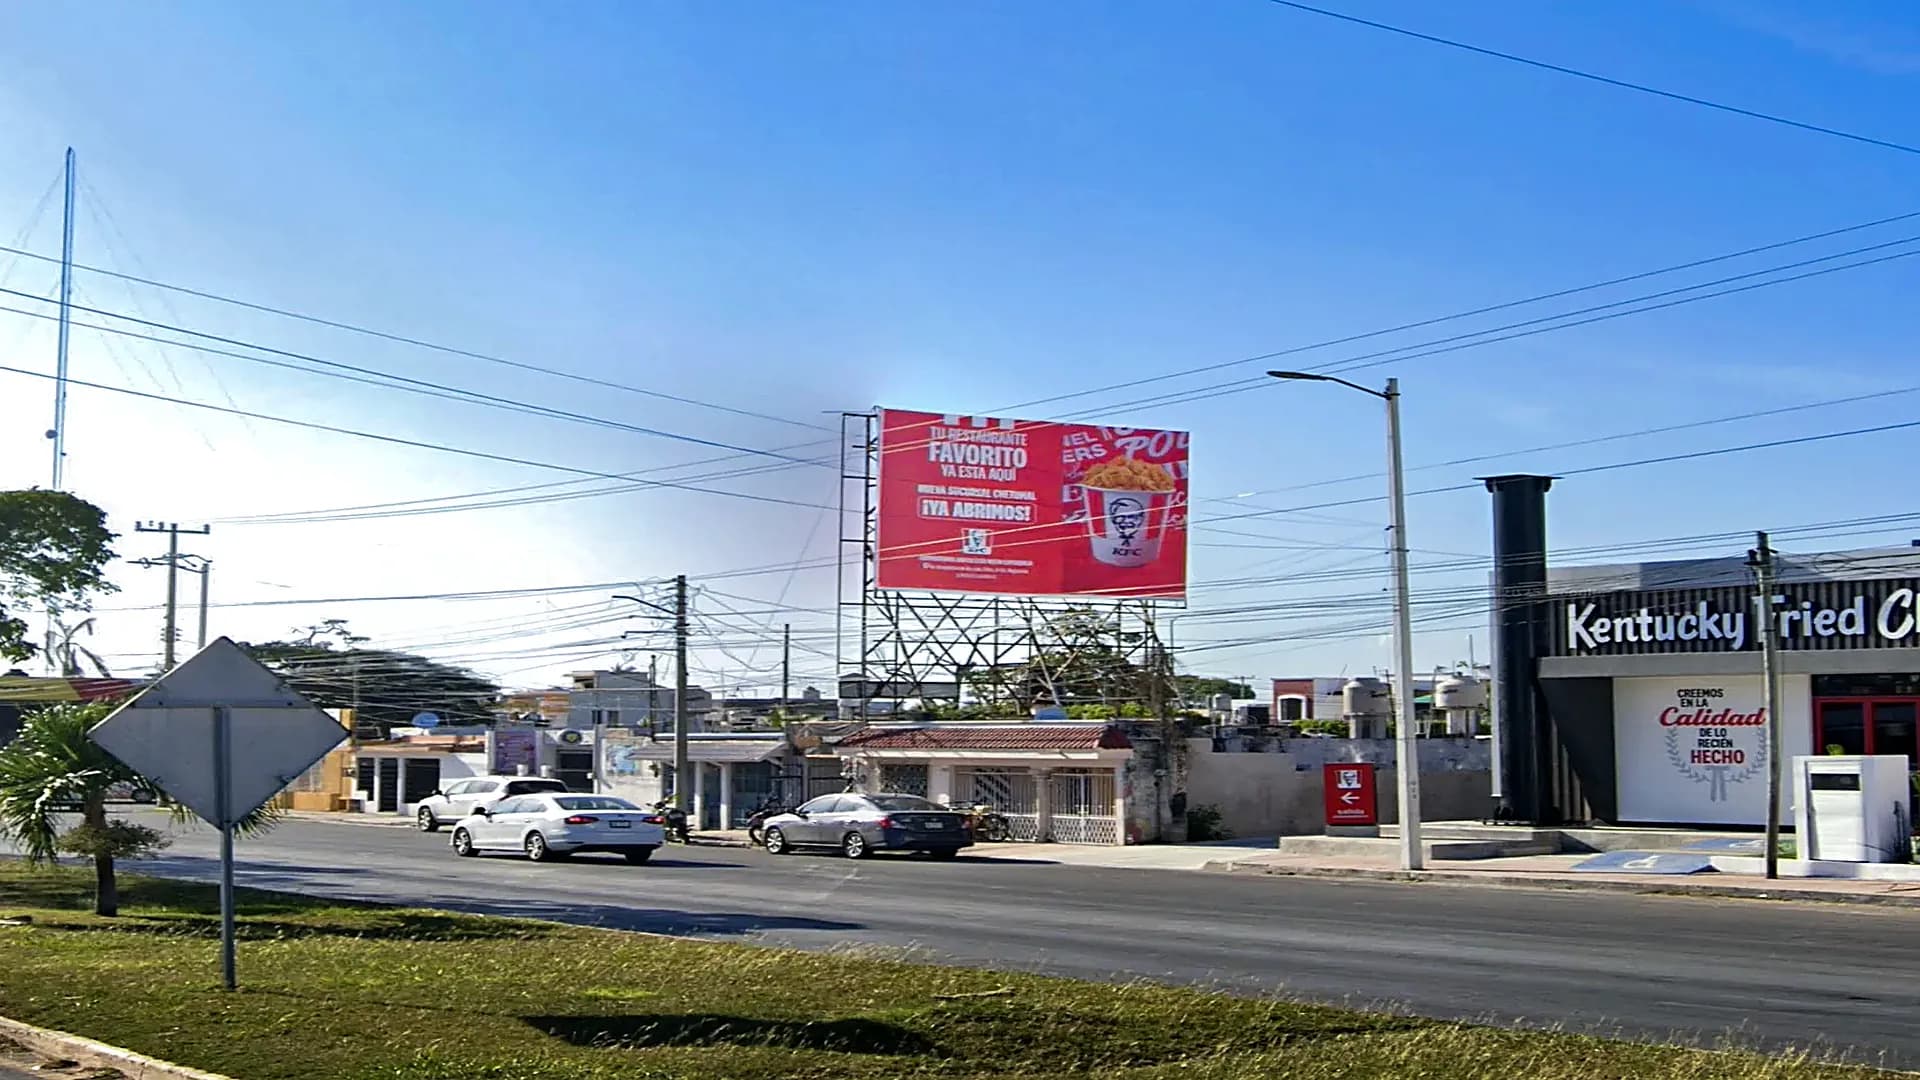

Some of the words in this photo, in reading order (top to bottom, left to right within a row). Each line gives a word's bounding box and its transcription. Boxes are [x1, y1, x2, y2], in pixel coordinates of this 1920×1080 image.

[928, 441, 1028, 468] FAVORITO
[941, 464, 956, 477] YA
[952, 502, 1032, 521] ABRIMOS!
[1567, 600, 1745, 650] Kentucky
[1677, 688, 1724, 698] CREEMOS
[1680, 698, 1693, 707] EN
[1696, 698, 1709, 707] LA
[1659, 706, 1767, 726] Calidad
[1699, 728, 1712, 737] DE
[1715, 728, 1727, 737] LO
[1690, 749, 1745, 764] HECHO
